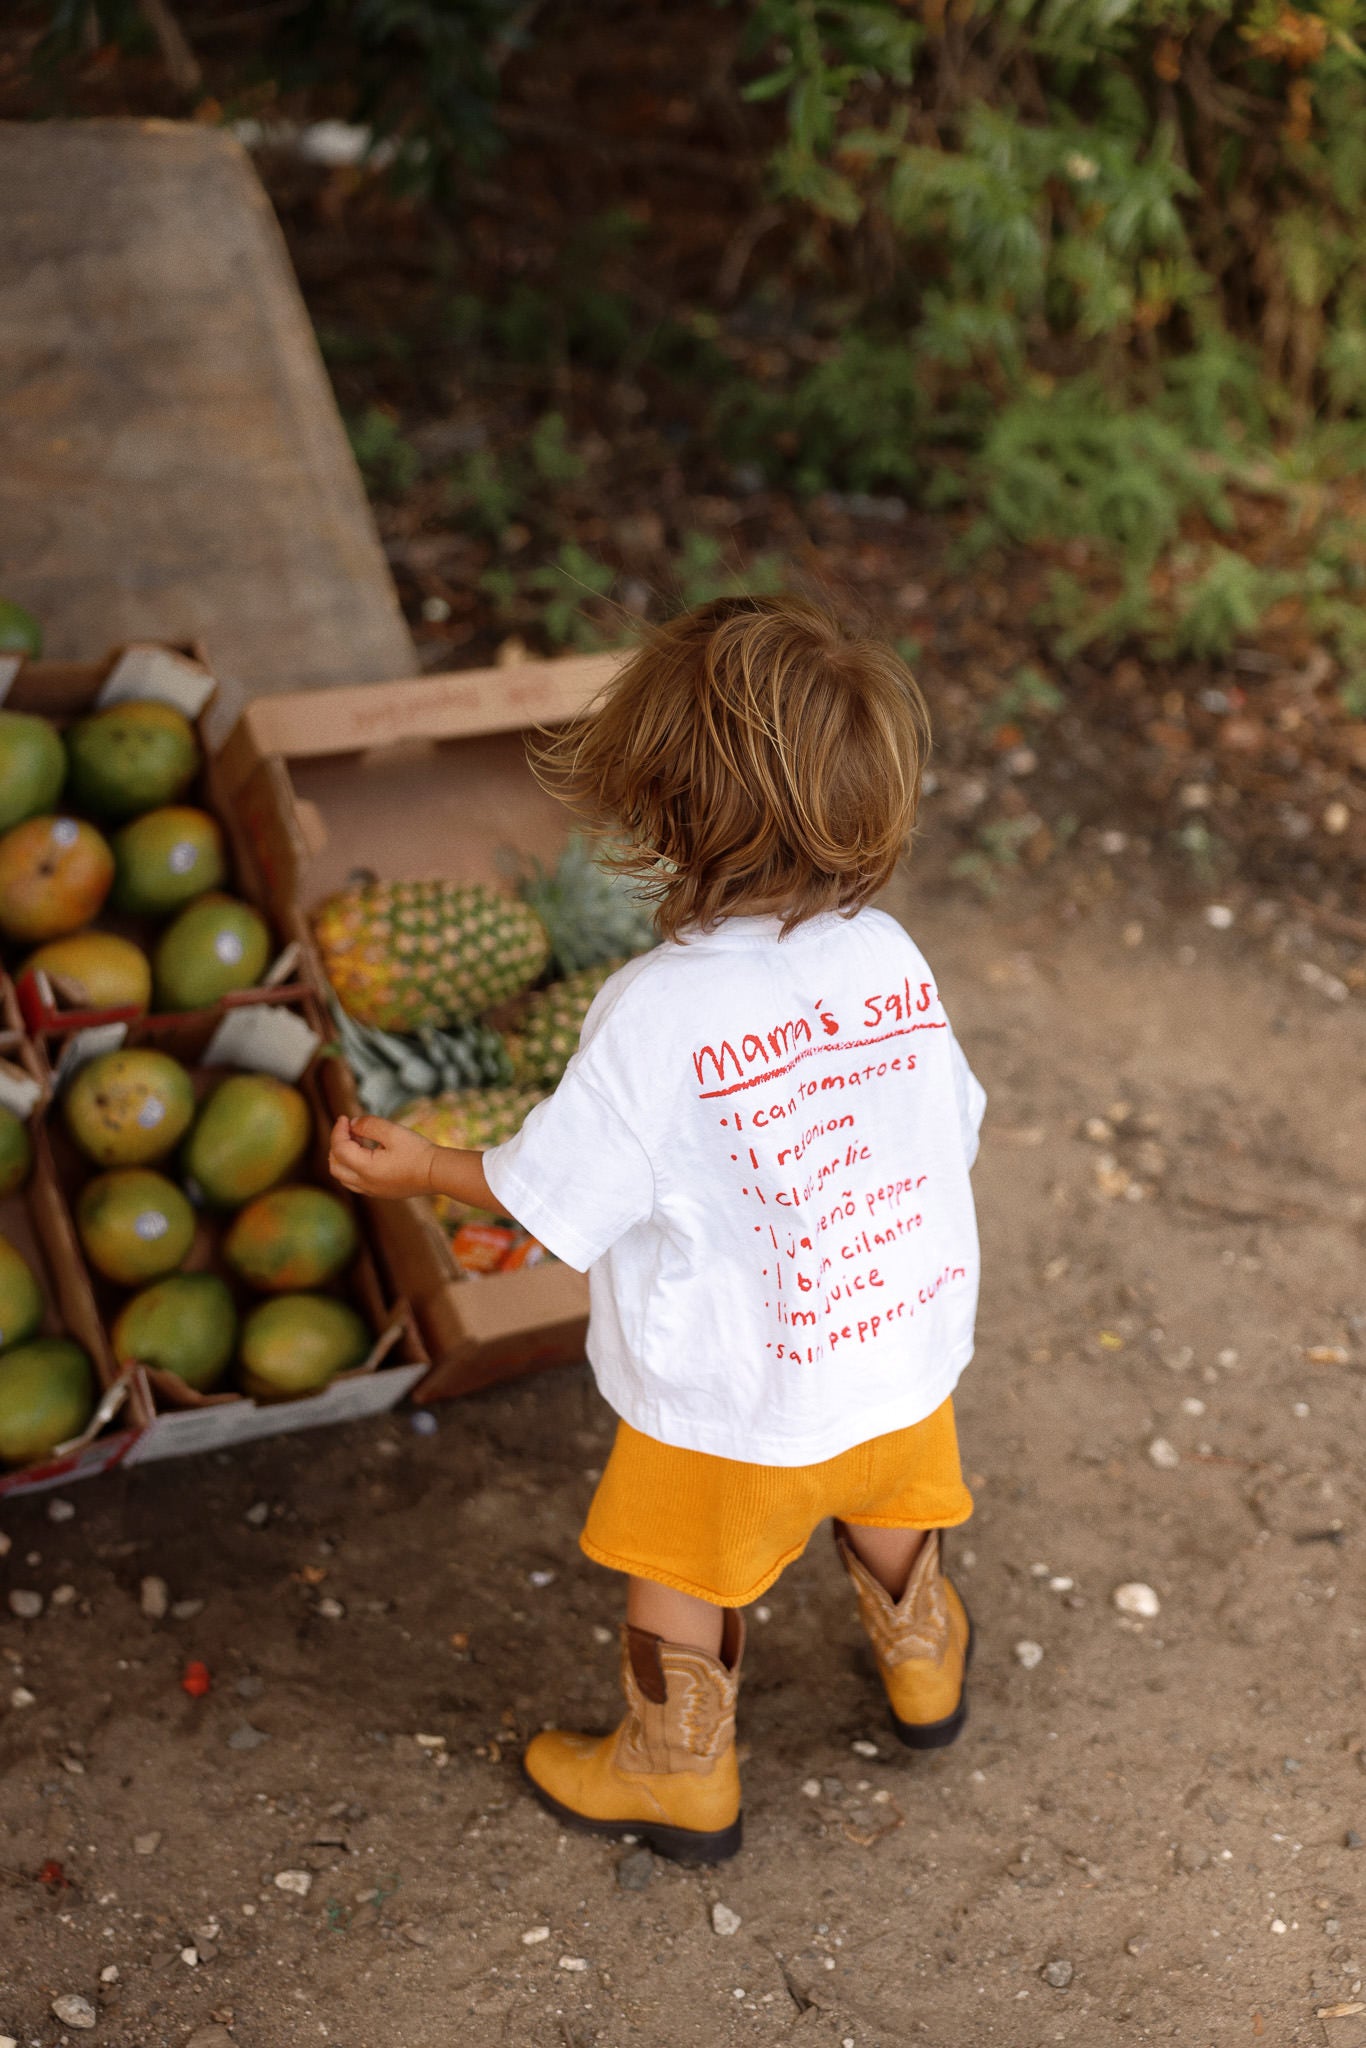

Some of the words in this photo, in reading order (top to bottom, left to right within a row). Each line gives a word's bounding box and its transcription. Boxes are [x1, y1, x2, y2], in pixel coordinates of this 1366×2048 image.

[863, 975, 940, 1027] Sals
[753, 1098, 797, 1128] can
[799, 1054, 917, 1100] tomatoes
[805, 1114, 855, 1145] onion
[817, 1141, 872, 1192] garlic
[865, 1174, 928, 1216] pepper
[841, 1213, 923, 1260] cilantro
[777, 1300, 821, 1327] lim
[824, 1268, 885, 1314] juice
